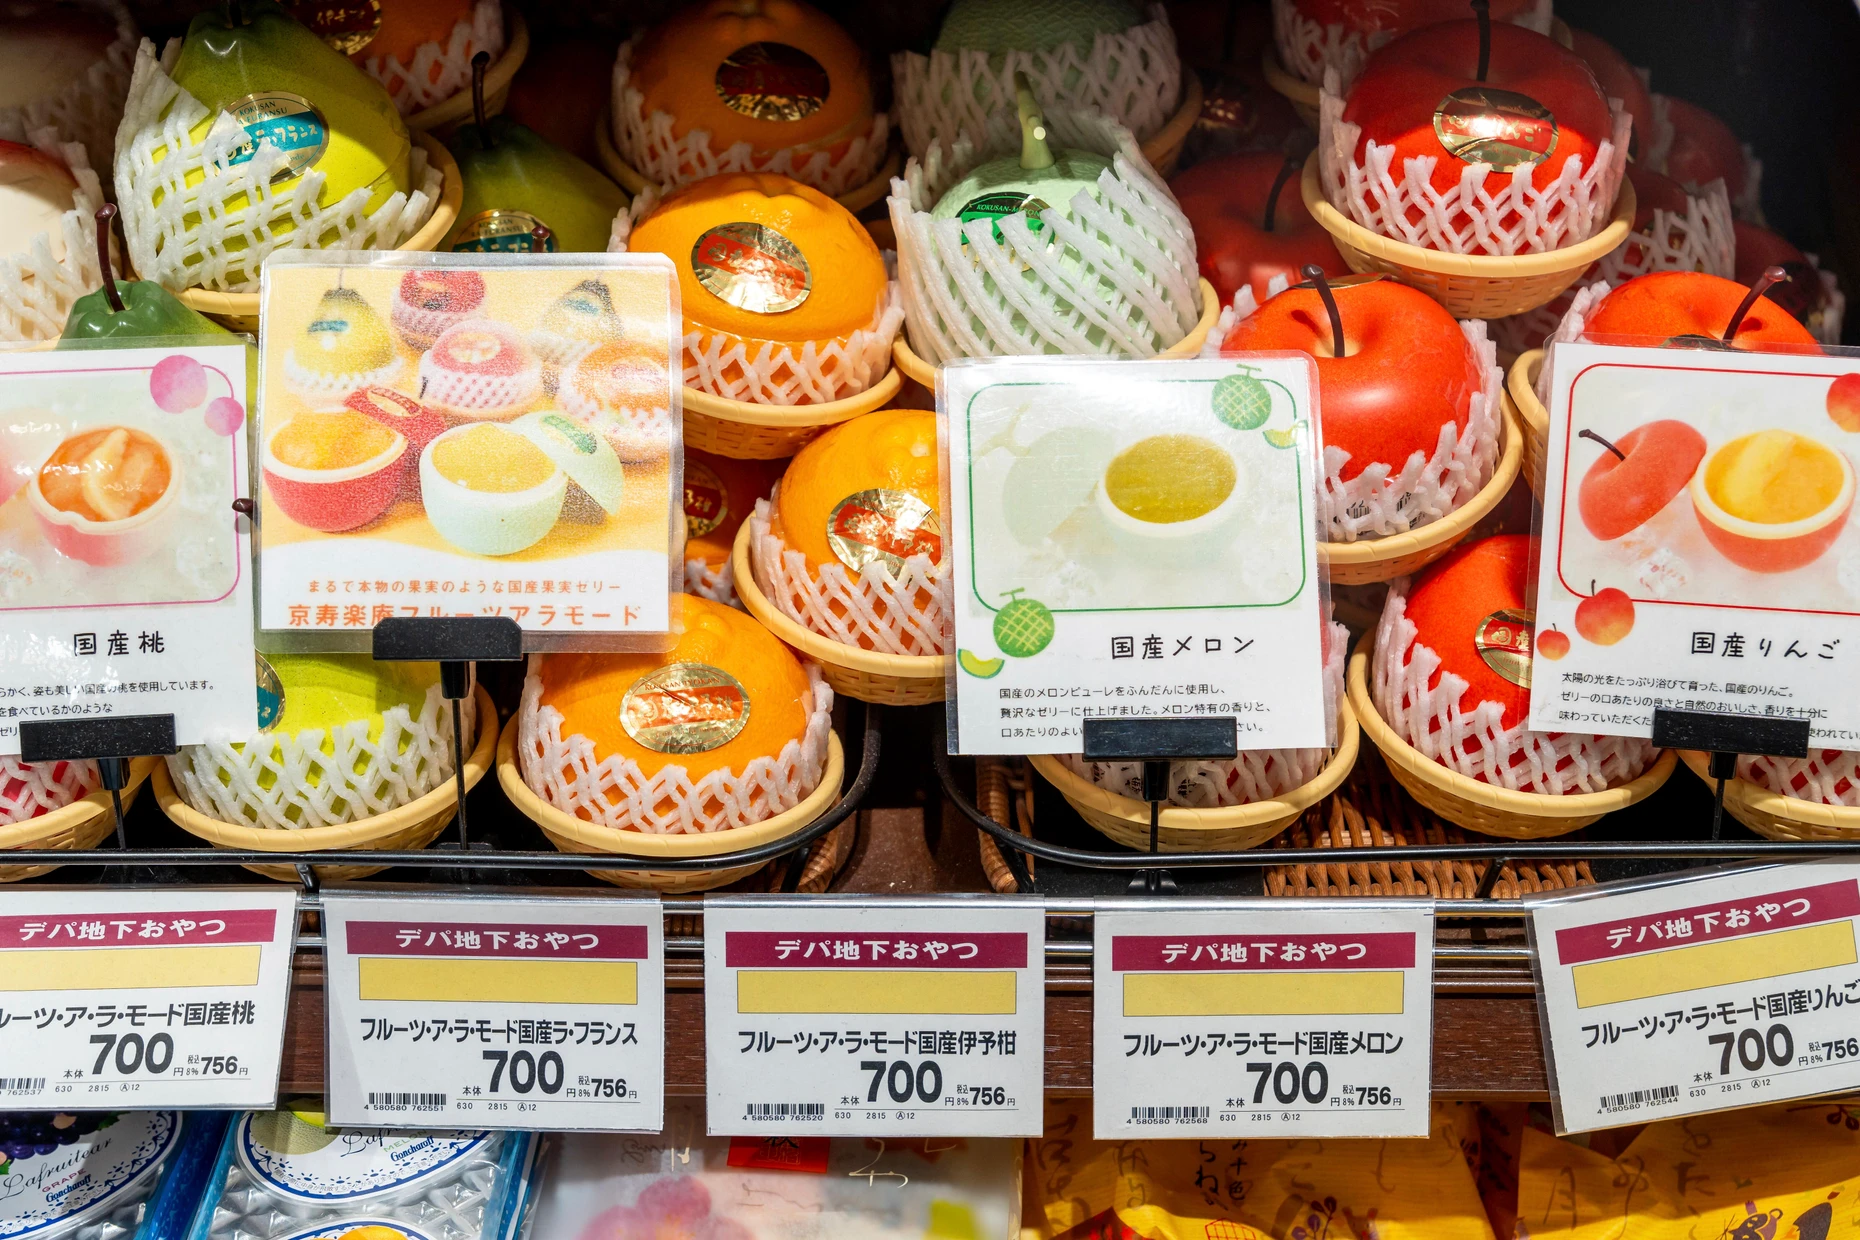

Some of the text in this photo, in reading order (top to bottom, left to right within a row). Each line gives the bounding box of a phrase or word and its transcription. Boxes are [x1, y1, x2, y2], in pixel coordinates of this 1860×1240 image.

[239, 101, 276, 117] KOKUSAN
[310, 580, 620, 593] まるで本物の果実のような国産果実ゼリー
[74, 630, 164, 656] 国産桃
[1112, 634, 1253, 659] 国産メロン
[1692, 632, 1839, 659] 国産りんご
[1561, 671, 1794, 698] 太陽の光をたっぷり浴びて育った、国産のりんご。
[1000, 701, 1271, 719] 贅沢なゼリーに仕上げました。メロン特有の香りと、
[20, 920, 226, 940] デパ地下おやつ
[1607, 898, 1810, 948] デパ地下おやつ
[396, 930, 599, 950] デパ地下おやつ
[775, 940, 978, 960] デパ地下おやつ
[1162, 942, 1366, 963] デパ地下おやつ
[1582, 980, 1860, 1048] フルーツ・ア・ラ・モード国産りんご
[361, 1018, 638, 1045] フルーツ・ア・ラ・モード国産ラ・フランス
[739, 1030, 1017, 1055] フルーツ・ア・ラ・モード国産伊予柑
[1123, 1031, 1403, 1056] フルーツ・ア・ラ・モード国産メロン
[63, 1069, 84, 1079] 本体
[89, 1032, 174, 1075] 700
[173, 1067, 184, 1076] 円
[186, 1068, 198, 1076] 8%
[201, 1056, 238, 1075] 756
[1693, 1072, 1712, 1083] 本体
[1708, 1024, 1794, 1075] 700
[1798, 1055, 1808, 1066] 円
[1810, 1055, 1823, 1065] 8%
[1821, 1037, 1859, 1061] 756
[463, 1086, 481, 1096] 本体
[483, 1051, 564, 1094] 700
[567, 1089, 575, 1097] 円
[579, 1089, 590, 1097] 8%
[591, 1079, 626, 1097] 756
[841, 1096, 859, 1105] 本体
[861, 1061, 942, 1103] 700
[945, 1097, 954, 1106] 円
[957, 1098, 968, 1106] 8%
[970, 1088, 1005, 1105] 756
[1226, 1098, 1244, 1108] 本体
[1247, 1062, 1328, 1104] 700
[1331, 1098, 1340, 1106] 円
[1343, 1098, 1354, 1106] 8%
[1356, 1087, 1391, 1105] 756
[88, 1084, 109, 1092] 2815
[1689, 1089, 1706, 1097] 630
[1721, 1083, 1741, 1092] 2815
[1607, 1103, 1640, 1113] 580580
[1646, 1097, 1678, 1108] 762544
[383, 1128, 427, 1153] MELON
[391, 1135, 435, 1163] Goncharoff
[0, 1137, 114, 1201] Lafruitear
[42, 1168, 87, 1193] GRAPE
[45, 1173, 92, 1203] Goncharoff
